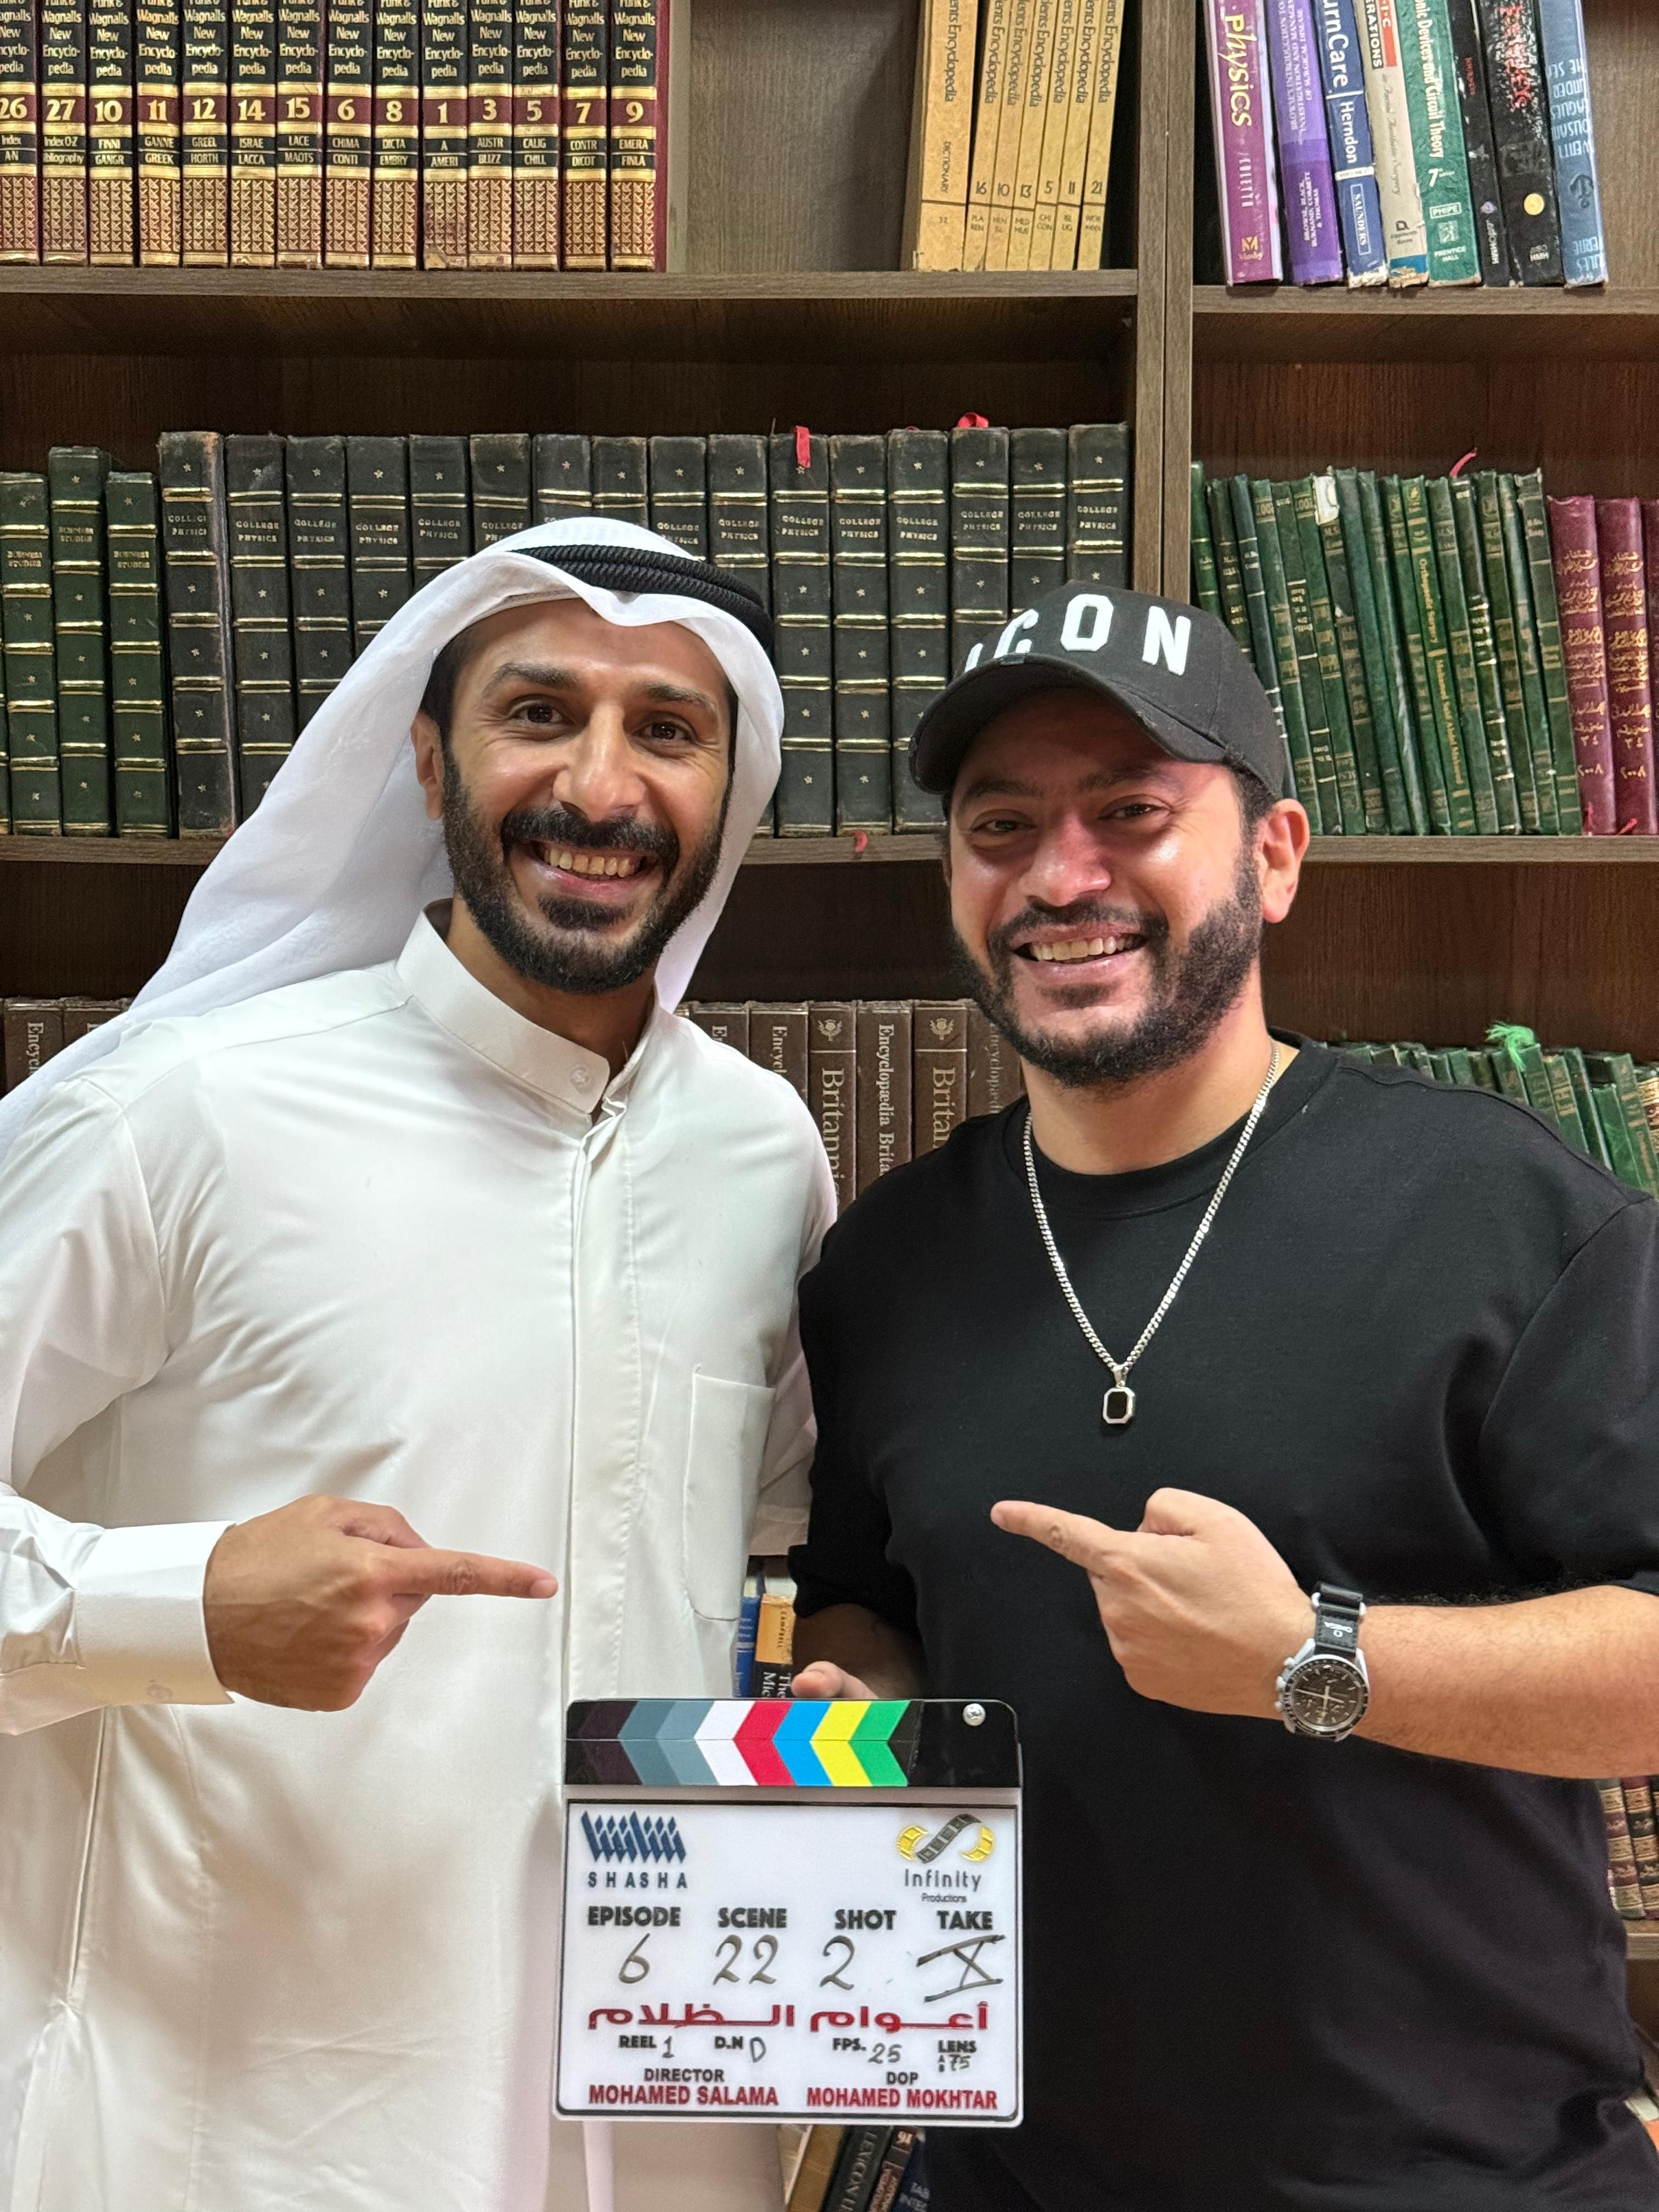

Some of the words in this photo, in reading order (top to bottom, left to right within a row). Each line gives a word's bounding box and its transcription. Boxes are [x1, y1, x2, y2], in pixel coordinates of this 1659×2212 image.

[89, 13, 129, 26] Wagnalls
[184, 9, 225, 24] Wagnalls
[279, 9, 320, 23] Wagnalls
[376, 12, 417, 26] Wagnalls
[97, 29, 119, 42] New
[194, 26, 216, 39] New
[287, 26, 309, 39] New
[385, 29, 406, 42] New
[1417, 19, 1434, 61] Devices
[96, 64, 122, 78] pedia
[192, 62, 218, 76] pedia
[286, 61, 311, 75] pedia
[382, 64, 408, 78] pedia
[1217, 13, 1257, 127] Physics
[1305, 88, 1312, 101] OF
[46, 99, 75, 121] 27
[192, 99, 216, 119] 12
[286, 97, 310, 119] 15
[337, 99, 355, 120] 6
[483, 99, 497, 121] 3
[1425, 86, 1444, 120] Circuit
[94, 100, 122, 122] 10
[148, 100, 167, 121] 11
[238, 100, 266, 121] 14
[386, 101, 402, 122] 8
[438, 102, 448, 123] 1
[527, 100, 542, 121] 5
[576, 103, 591, 123] 7
[625, 102, 644, 123] 9
[1340, 101, 1359, 163] Herndon
[2, 136, 21, 145] Index
[44, 136, 64, 146] Index
[99, 139, 120, 149] FINNI
[192, 138, 217, 147] GREEL
[240, 138, 263, 148] ISRAE
[289, 136, 309, 146] LACE
[332, 138, 359, 148] CHIMA
[382, 139, 406, 149] DICTA
[441, 141, 448, 151] A
[477, 138, 503, 148] AUSTR
[523, 138, 546, 148] CALIG
[570, 140, 597, 150] CONTR
[619, 139, 648, 149] EMERA
[1429, 121, 1446, 158] Theory
[95, 154, 125, 165] GANGR
[145, 154, 174, 164] GREEK
[191, 154, 218, 163] HORTH
[239, 155, 265, 164] LACCA
[333, 154, 358, 163] CONTI
[431, 157, 458, 167] AMERI
[572, 156, 595, 166] DICOT
[622, 156, 645, 166] FINLA
[940, 140, 952, 193] DICTIONARY
[976, 181, 987, 194] 16
[998, 184, 1010, 196] 10
[1020, 184, 1032, 198] 13
[1045, 181, 1053, 194] 5
[1069, 182, 1075, 194] 11
[1091, 180, 1103, 195] 21
[1353, 193, 1367, 246] SAUNDERS
[1442, 254, 1459, 262] HALL
[963, 593, 1191, 676] ICON
[588, 1871, 688, 1888] SHASHA
[905, 1869, 981, 1892] Infinity
[921, 1893, 967, 1903] Productions
[588, 1906, 681, 1927] EPISODE
[718, 1907, 787, 1928] SCENE
[834, 1909, 896, 1930] SHOT
[936, 1910, 994, 1930] TAKE
[618, 1933, 650, 1984] 6
[713, 1934, 778, 1985] 22
[820, 1936, 855, 1990] 2
[618, 2035, 657, 2049] REEL
[714, 2036, 744, 2049] D.N
[832, 2038, 866, 2051] FPS.
[938, 2040, 977, 2053] LENS
[662, 2036, 674, 2059] 1
[868, 2043, 903, 2064] 25
[644, 2068, 724, 2082] DIRECTOR
[886, 2072, 918, 2084] DOP
[588, 2085, 690, 2104] MOHAMED
[697, 2086, 778, 2106] SALAMA
[806, 2087, 900, 2107] MOHAMED
[906, 2088, 997, 2110] MOKHTAR
